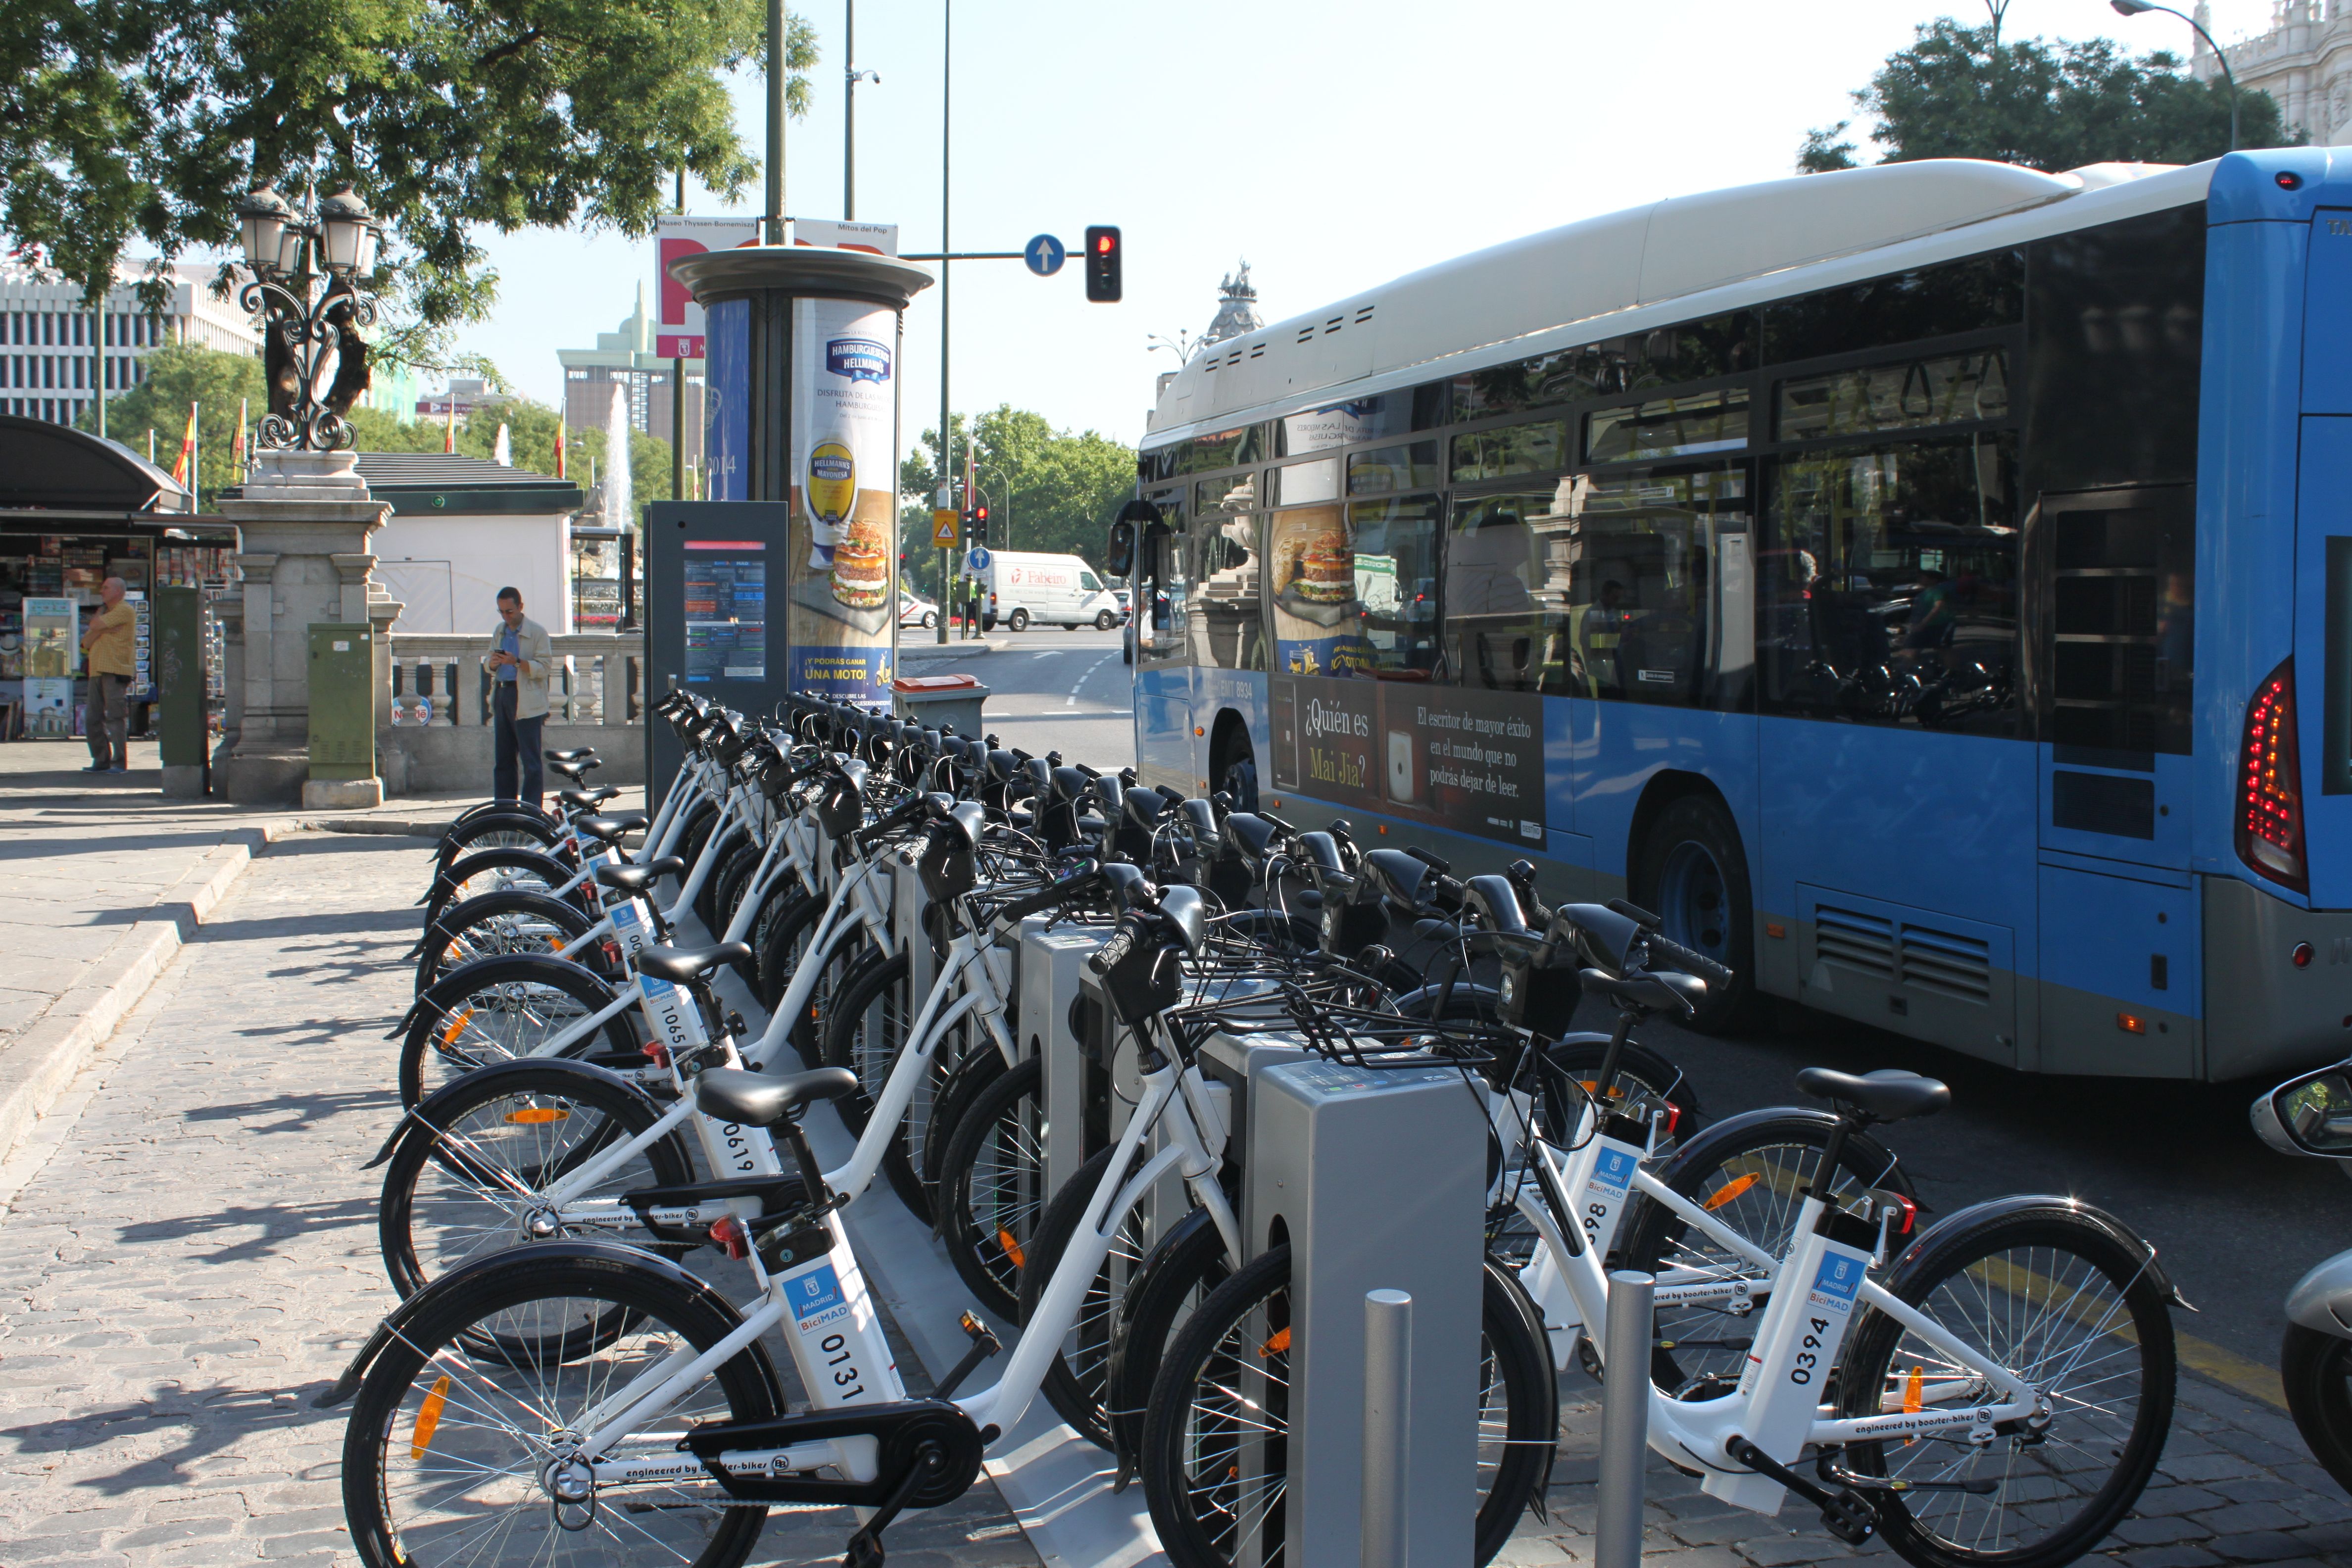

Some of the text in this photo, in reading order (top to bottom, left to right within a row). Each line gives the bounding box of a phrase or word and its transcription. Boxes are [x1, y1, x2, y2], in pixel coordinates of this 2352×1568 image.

[2327, 219, 2352, 236] TA
[833, 344, 889, 363] HAMBURGUESEROS
[844, 358, 884, 374] HELLMANN'S
[817, 389, 853, 398] DISFRUTA
[708, 455, 736, 475] 2014
[814, 460, 850, 469] HELLMANN'S
[817, 470, 847, 478] MAYONESA
[1027, 571, 1066, 584] Fabeiro
[814, 657, 844, 665] PODRÁS
[805, 669, 866, 680] UNA MOTO!
[1221, 680, 1252, 699] EMT 8934
[1306, 698, 1368, 738] ¿Quién es
[1418, 706, 1531, 738] El escritor de mayor éxito
[1430, 738, 1517, 767] en el mundo que no
[1310, 746, 1366, 788] Mai Jia?
[1430, 765, 1519, 798] podrás dejar de leer.
[619, 923, 640, 934] BiciMAD
[630, 935, 642, 950] 00
[649, 991, 676, 1005] BiciMAD
[662, 1005, 686, 1043] 1065
[723, 1123, 754, 1171] 0619
[1588, 1182, 1622, 1199] BiciMAD
[583, 1216, 622, 1224] engineered
[1683, 1288, 1731, 1298] booster-bikes
[1810, 1293, 1849, 1312] BiciMAD
[801, 1306, 847, 1331] BiciMAD
[1791, 1317, 1829, 1385] 0394
[821, 1334, 864, 1400] 0131
[1855, 1421, 1902, 1434] engineered
[1918, 1414, 1974, 1427] booster-bikes
[626, 1465, 682, 1477] engineered
[685, 1464, 697, 1474] by
[700, 1462, 767, 1472] bter-bikes
[376, 1441, 395, 1534] STRONG
